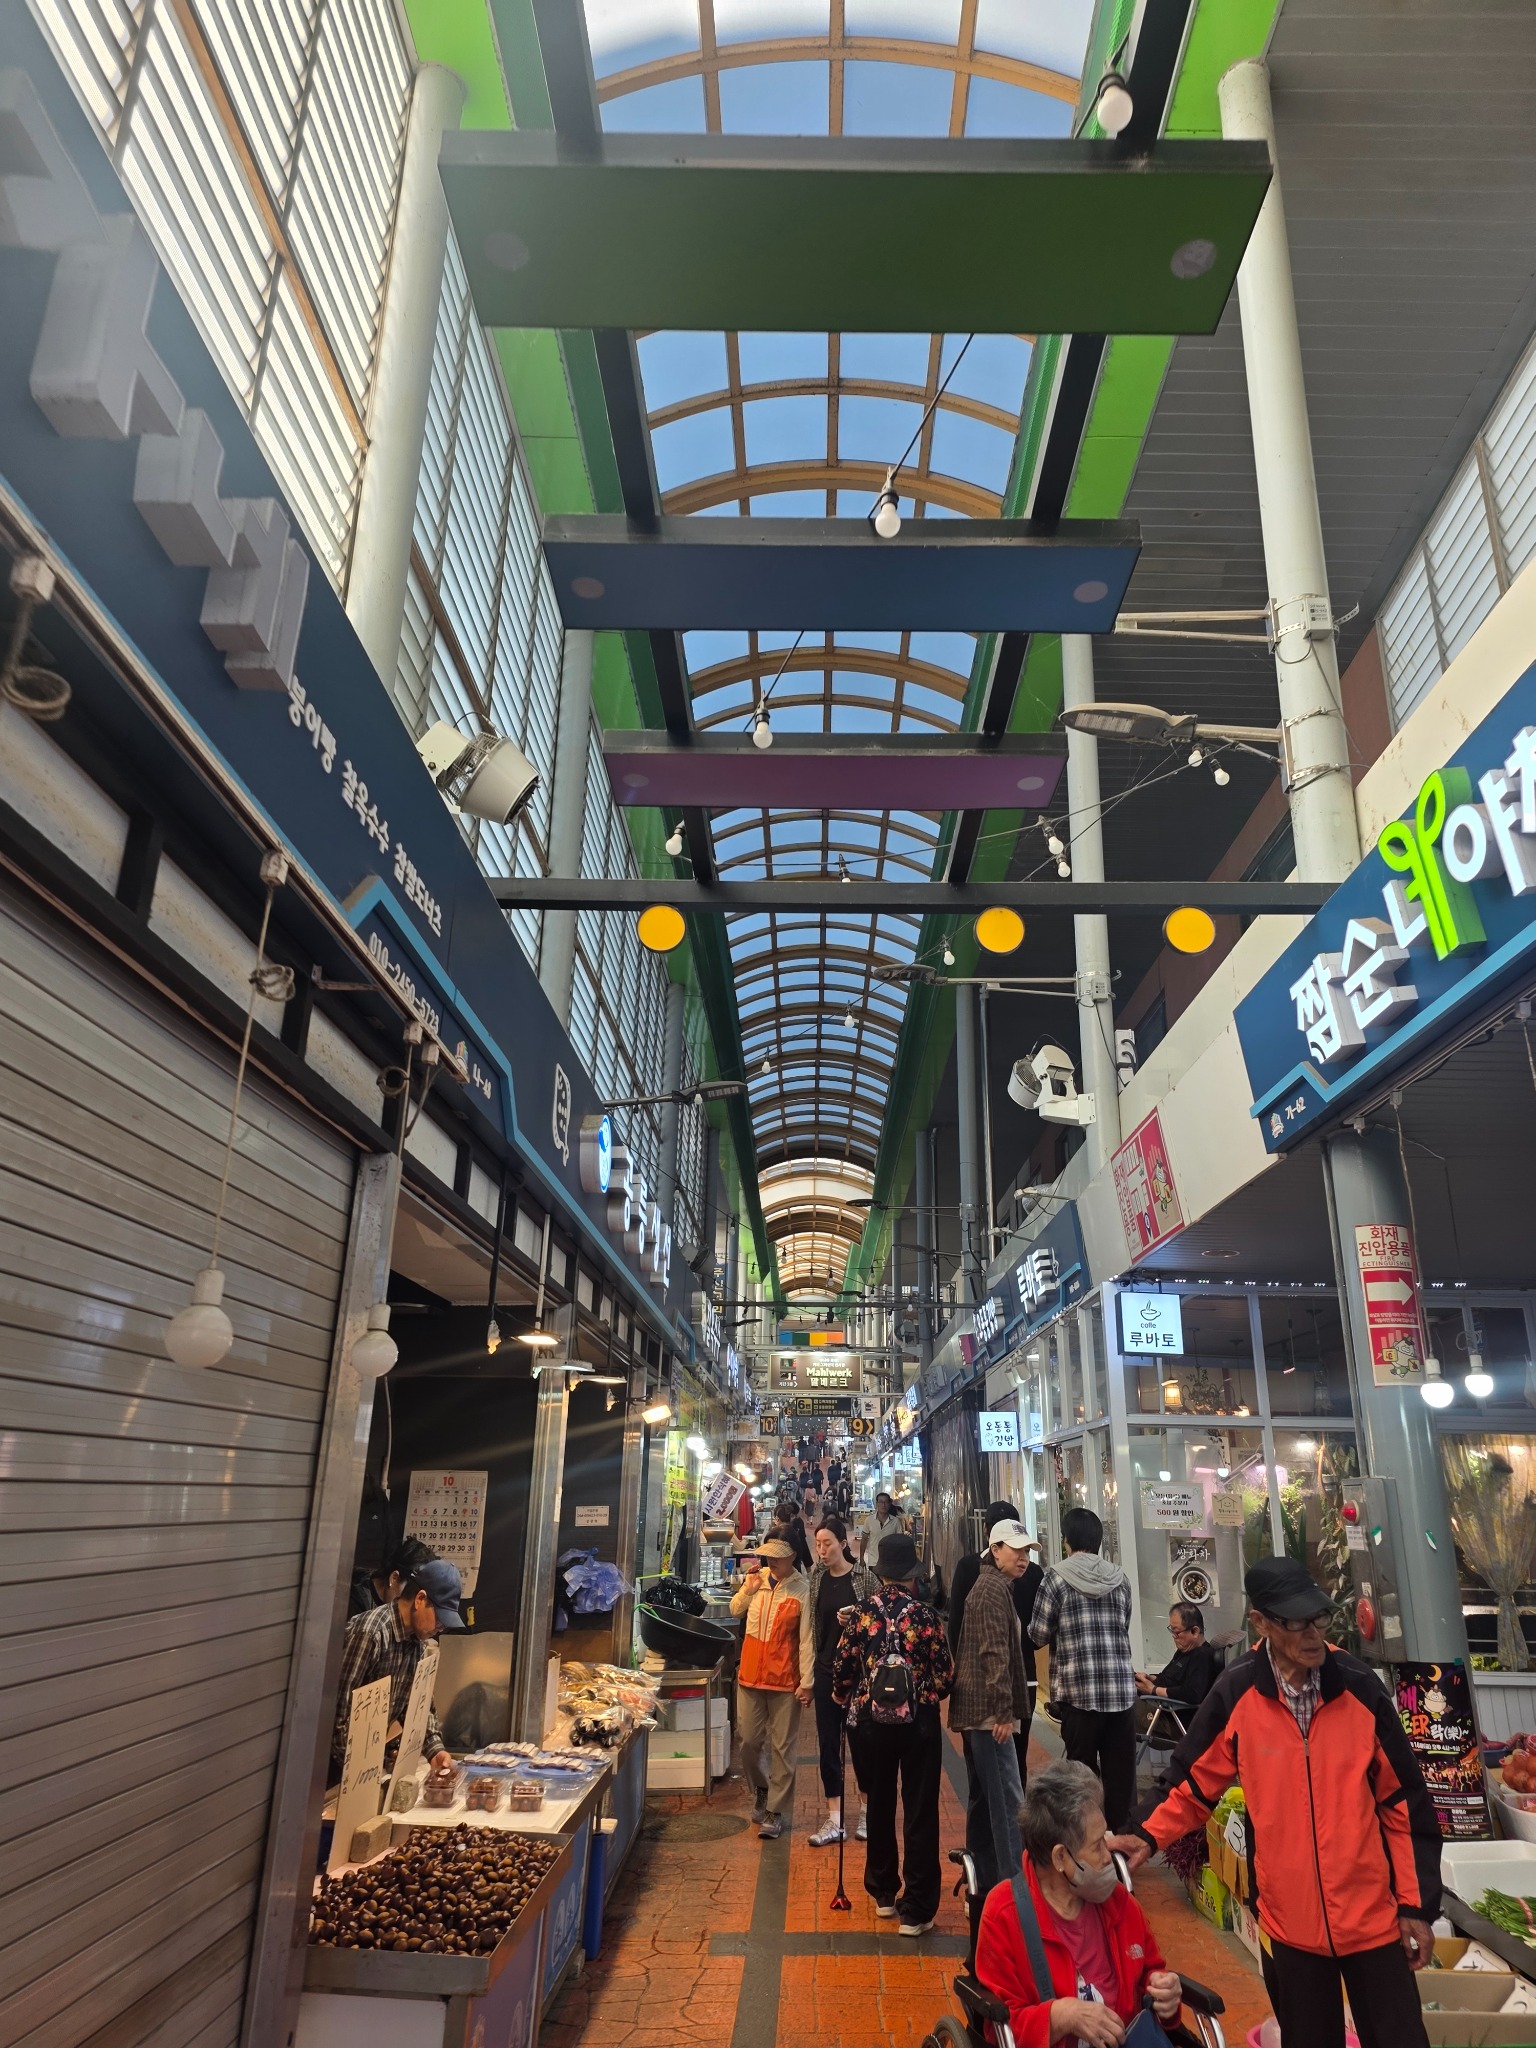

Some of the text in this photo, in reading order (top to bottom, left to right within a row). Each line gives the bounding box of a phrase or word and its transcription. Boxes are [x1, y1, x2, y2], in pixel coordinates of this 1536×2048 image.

[288, 673, 442, 938] 붕어빵 찰옥수수 찹쌀도너츠
[1370, 1226, 1399, 1242] 화재
[1359, 1240, 1411, 1257] 진압용품
[1130, 1331, 1176, 1348] 루바토
[806, 1367, 853, 1378] Mahlwerk
[810, 1377, 849, 1388] 말베르크
[852, 1418, 864, 1436] 9
[986, 1421, 1012, 1433] 오동통
[443, 1476, 454, 1486] 10
[464, 1496, 468, 1504] 2
[411, 1520, 477, 1528] 11 12 13 14 15 16 17
[438, 1544, 445, 1552] 28
[447, 1544, 455, 1552] 29
[457, 1544, 465, 1552] 30
[468, 1544, 475, 1552] 31
[1177, 1548, 1211, 1561] 쌍화차
